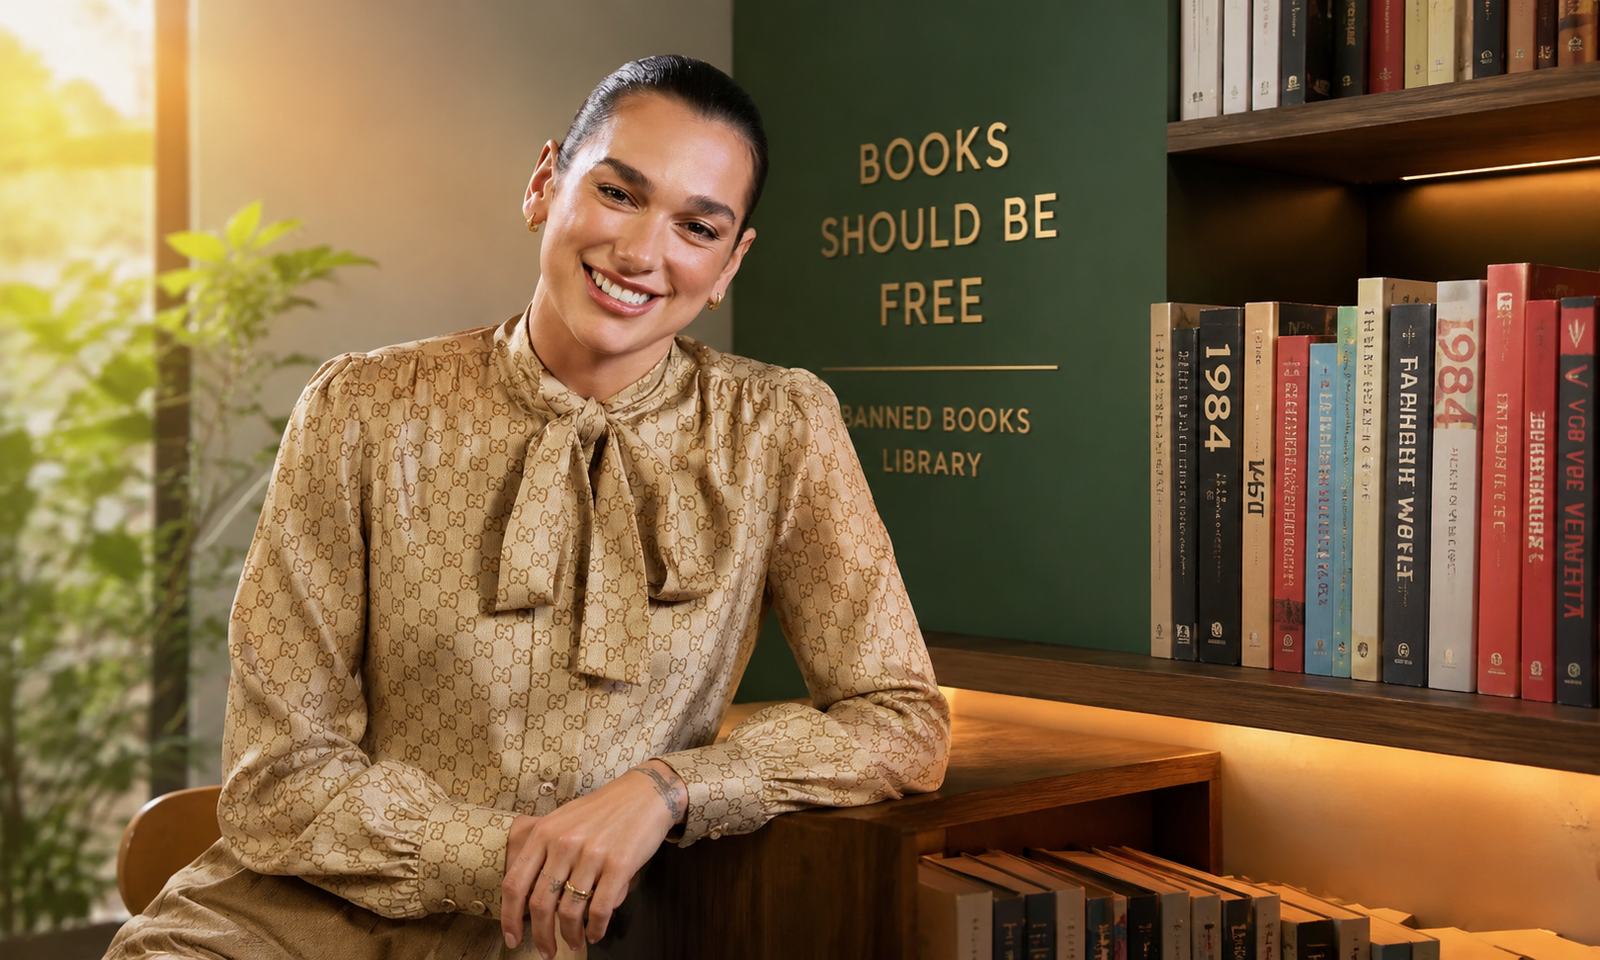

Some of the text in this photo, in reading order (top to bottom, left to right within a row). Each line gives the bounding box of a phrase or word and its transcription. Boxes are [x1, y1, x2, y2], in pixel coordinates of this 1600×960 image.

[860, 122, 1009, 185] BOOKS
[821, 192, 1058, 257] SHOULD BE
[880, 276, 983, 326] FREE
[1204, 345, 1231, 452] 1984
[1438, 319, 1478, 429] 1984
[843, 405, 1031, 433] BANNED BOOKS
[882, 448, 981, 477] LIBRARY
